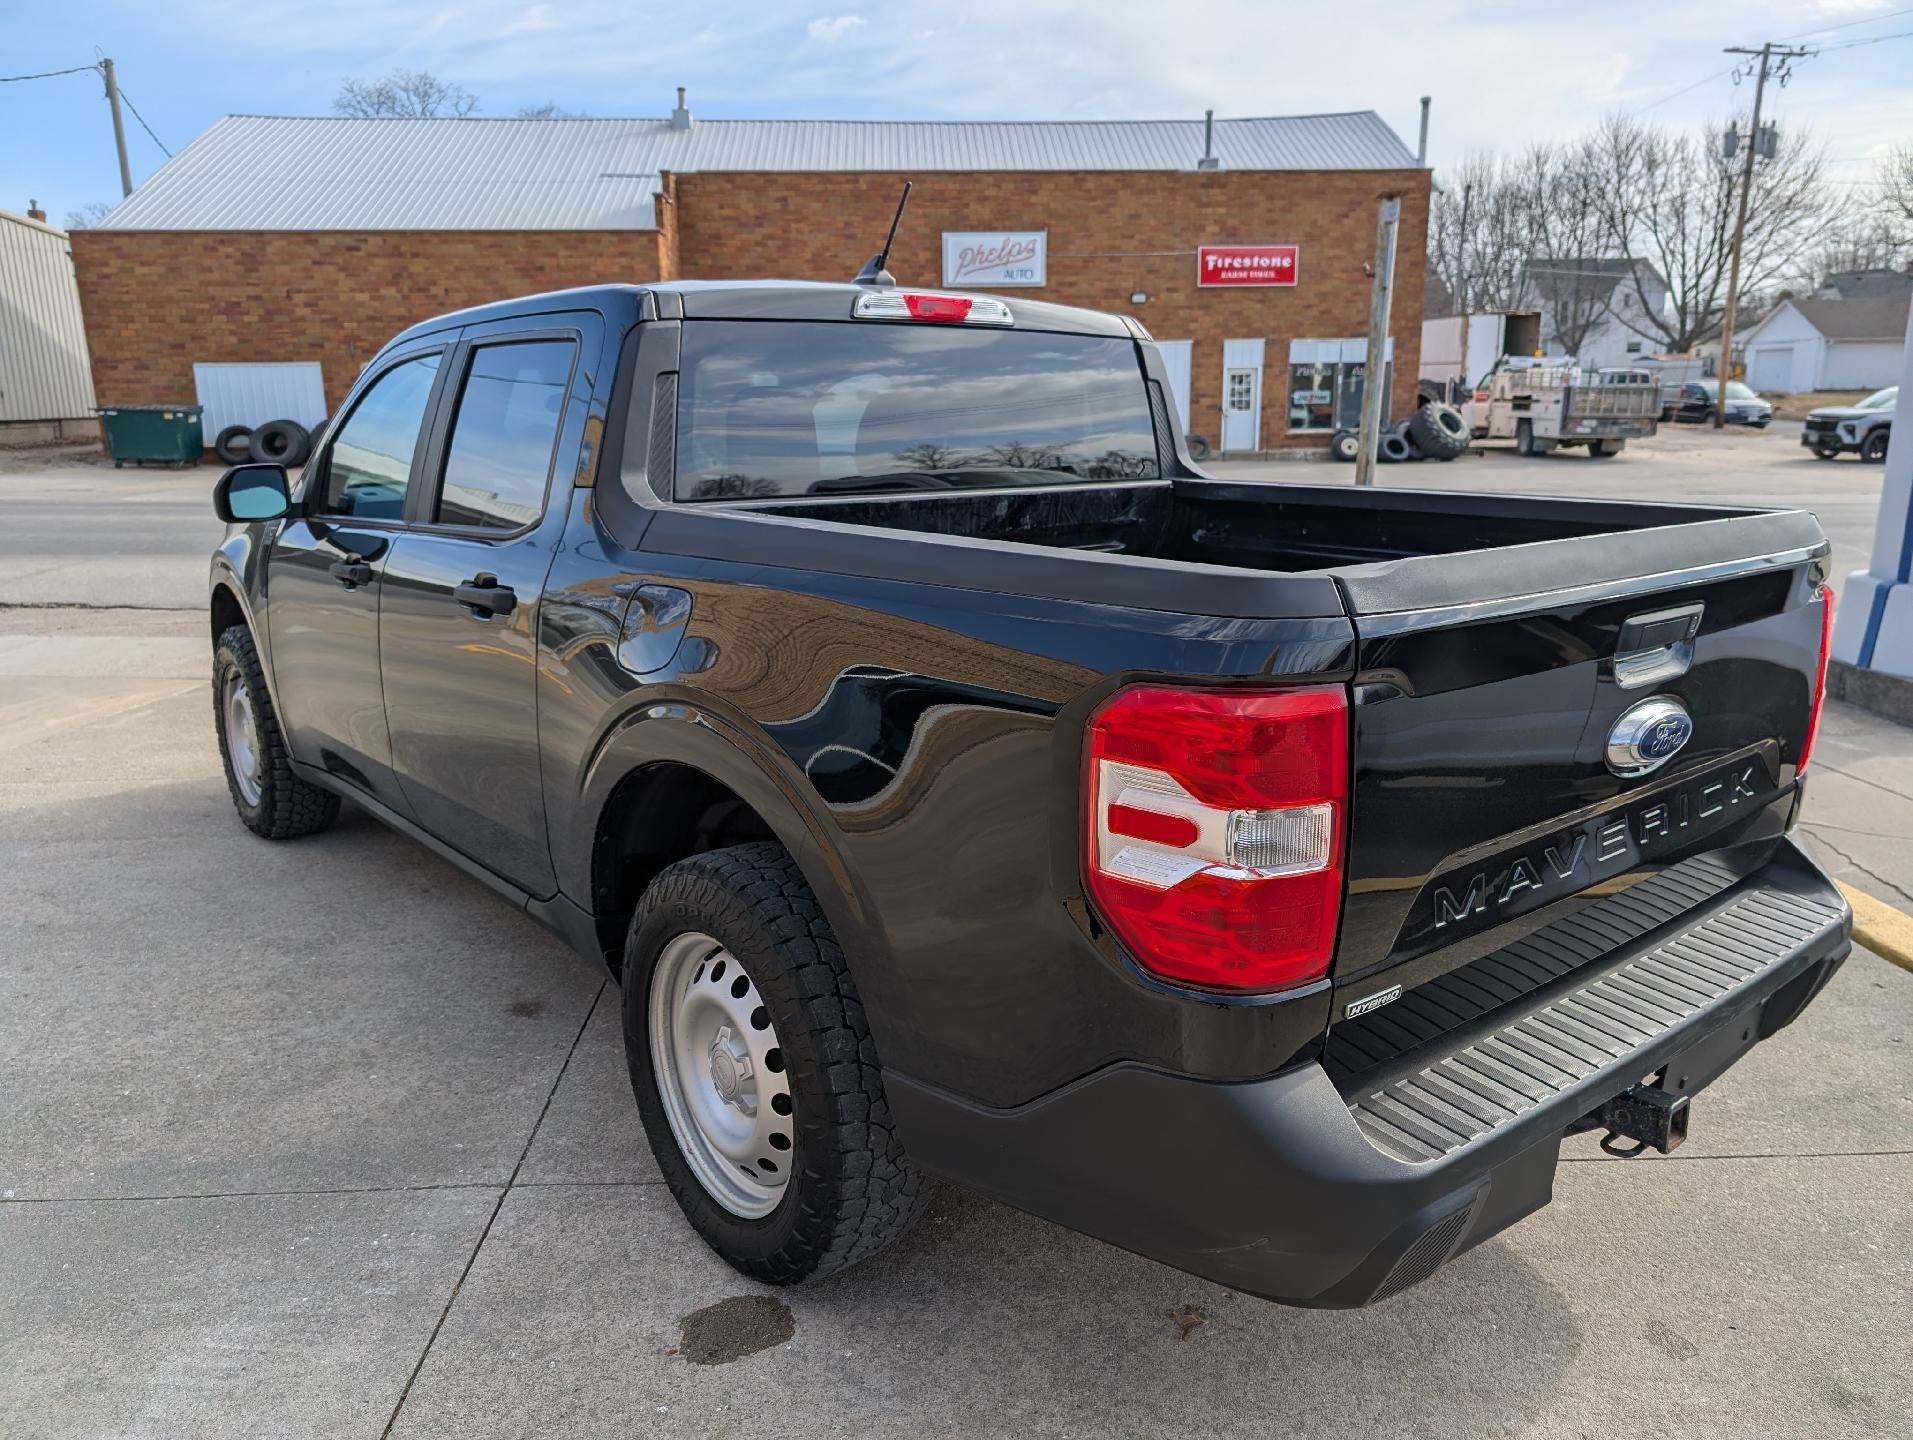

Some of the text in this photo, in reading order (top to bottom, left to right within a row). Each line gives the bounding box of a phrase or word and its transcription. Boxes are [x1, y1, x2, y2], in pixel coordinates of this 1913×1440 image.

[1004, 269, 1034, 281] AUTO
[1205, 254, 1292, 271] Firestone
[1650, 720, 1685, 755] Ford
[1433, 766, 1754, 928] MAVERICK
[1349, 989, 1400, 1017] HYBRID
